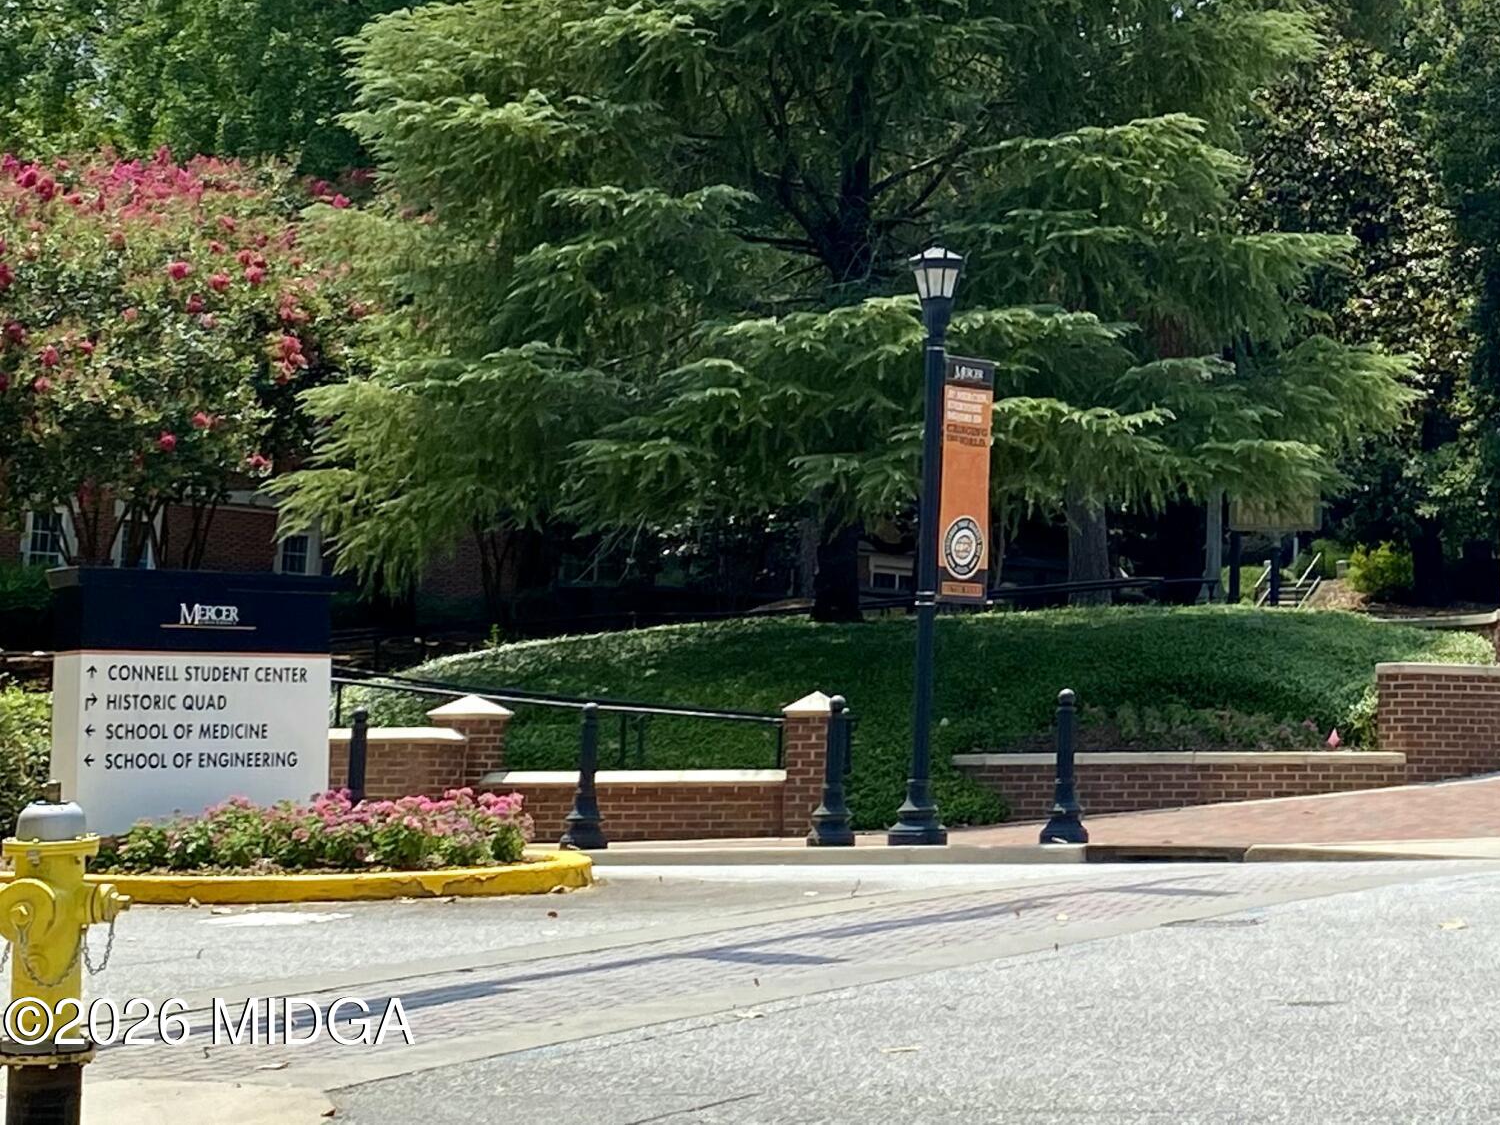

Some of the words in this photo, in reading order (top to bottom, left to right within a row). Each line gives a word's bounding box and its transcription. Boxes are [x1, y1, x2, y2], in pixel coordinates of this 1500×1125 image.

[179, 603, 240, 625] MERCER
[107, 664, 179, 683] CONNELL
[184, 665, 249, 683] STUDENT
[254, 666, 308, 683] CENTER
[106, 693, 177, 711] HISTORIC
[182, 694, 227, 711] QUAD
[105, 723, 169, 740] SCHOOL
[173, 723, 193, 740] OF
[198, 723, 268, 740] MEDICINE
[104, 752, 168, 770] SCHOOL
[172, 751, 193, 769] OF
[199, 751, 298, 768] ENGINEERING
